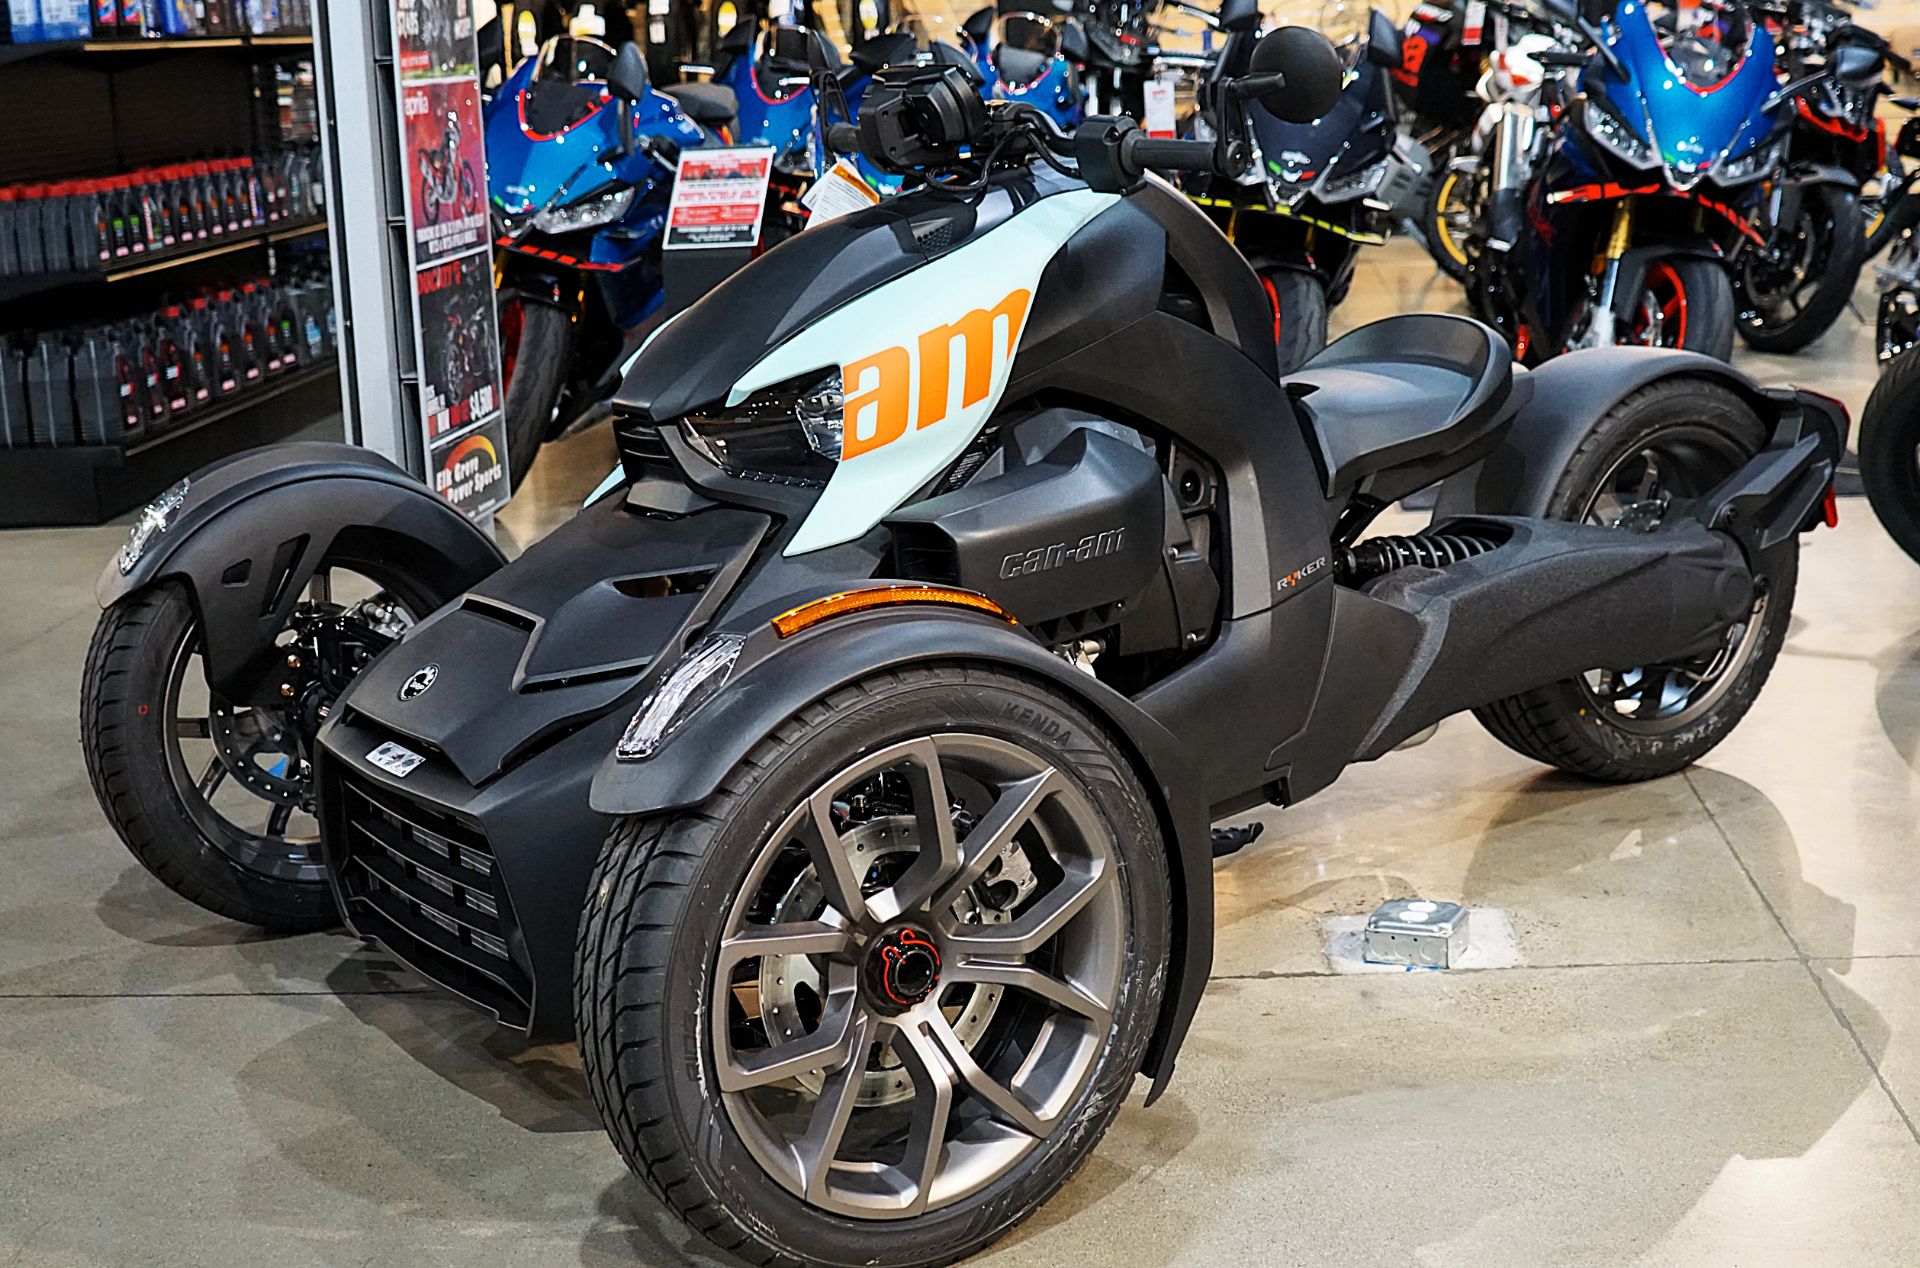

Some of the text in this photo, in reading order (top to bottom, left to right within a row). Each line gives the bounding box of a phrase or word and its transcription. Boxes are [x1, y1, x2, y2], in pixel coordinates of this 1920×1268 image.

[436, 456, 479, 492] Elk Grove
[447, 463, 502, 504] Power Sports
[999, 527, 1125, 580] can-am
[1003, 702, 1072, 747] KENDA
